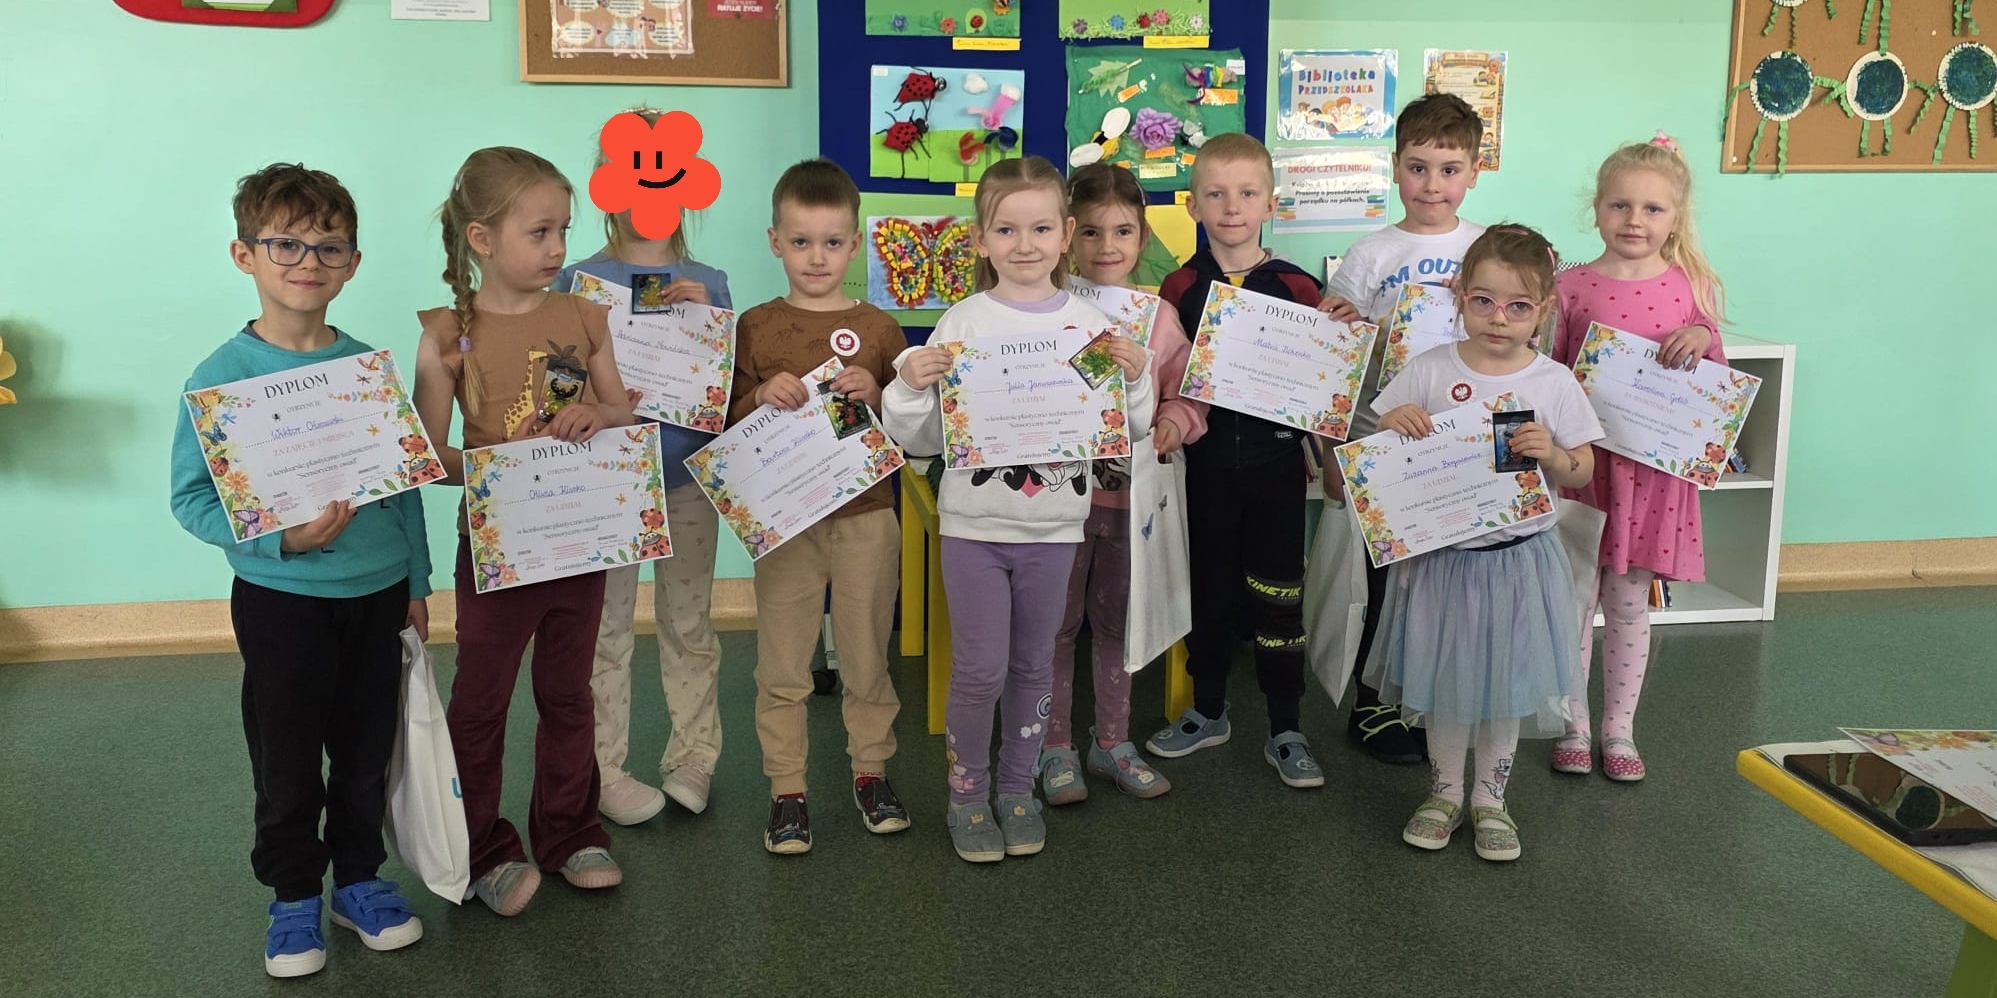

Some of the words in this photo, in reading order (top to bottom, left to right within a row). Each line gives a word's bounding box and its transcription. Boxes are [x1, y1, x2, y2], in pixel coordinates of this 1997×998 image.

[1288, 165, 1315, 174] DROGI
[1317, 164, 1371, 173] CZYTELNIKU!
[1265, 304, 1318, 328] DYPLOM
[1001, 340, 1057, 355] DYPLOM
[264, 373, 329, 399] DYPLOM
[742, 407, 783, 438] DYPLO
[532, 441, 592, 460] DYPLOM
[1402, 465, 1438, 481] Zuzanna
[1246, 576, 1301, 597] KINETIK
